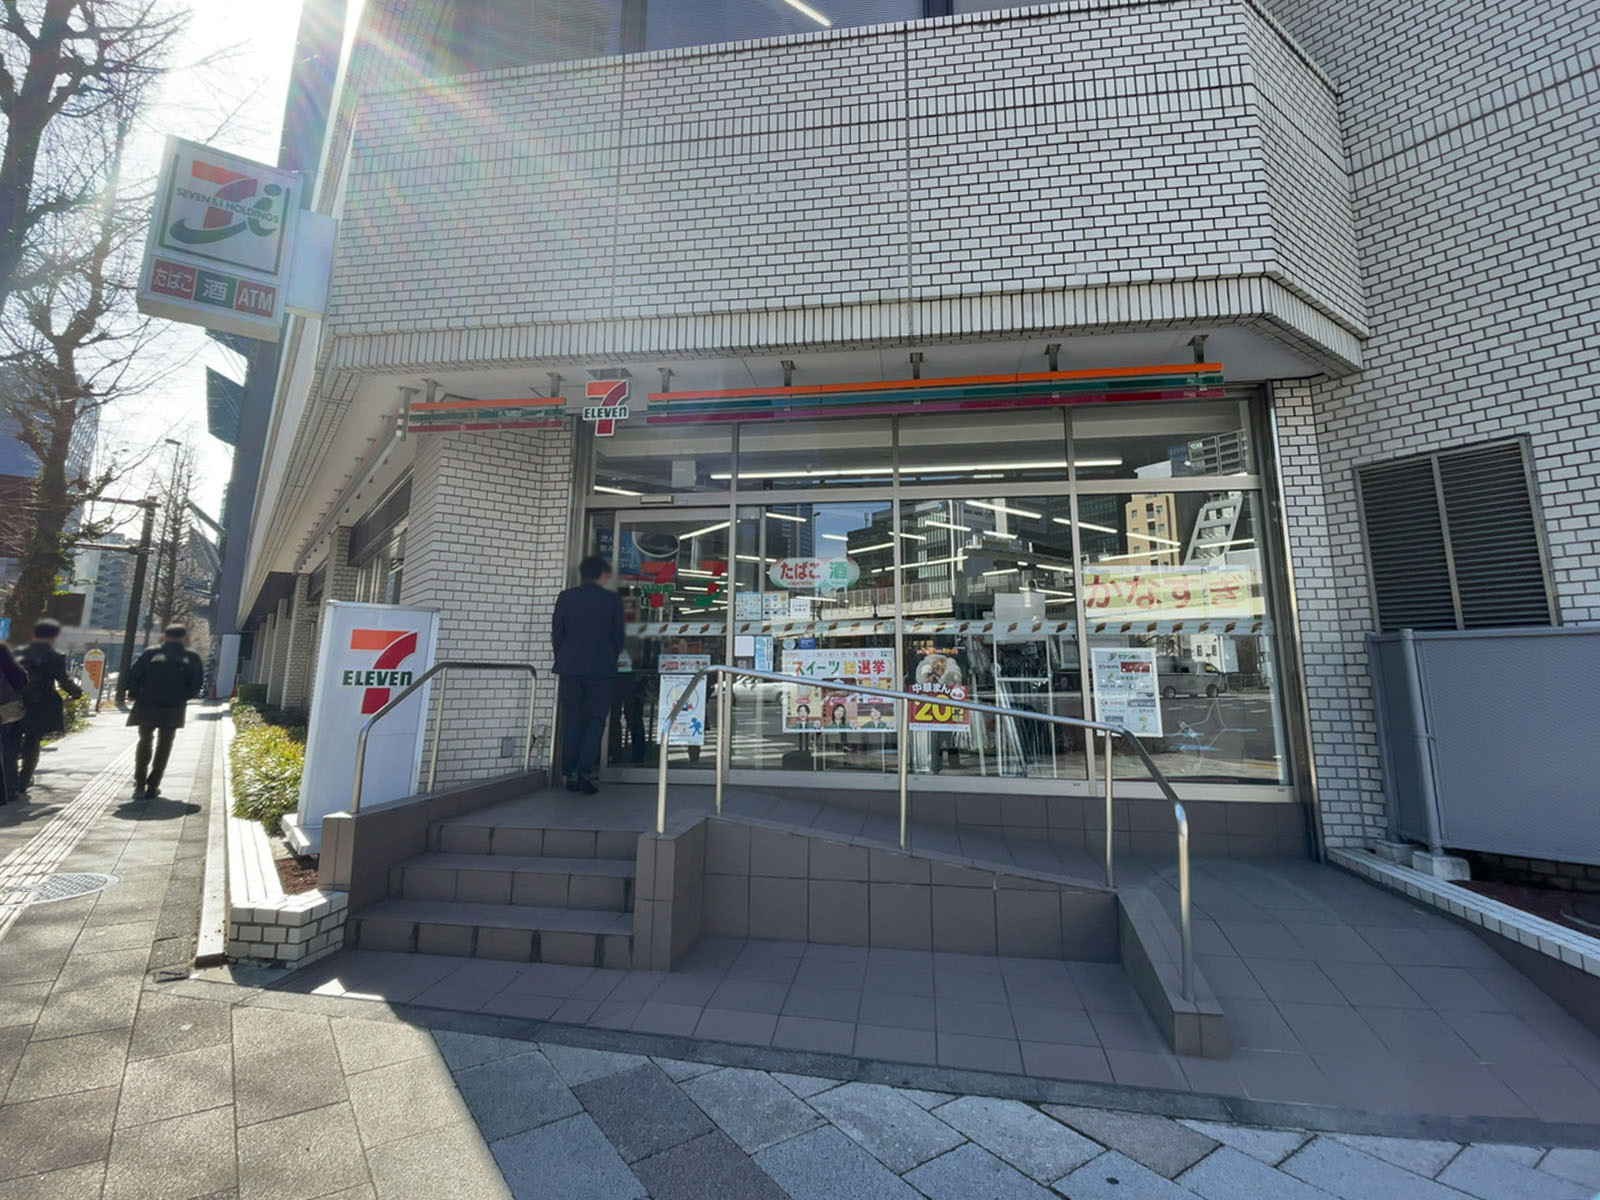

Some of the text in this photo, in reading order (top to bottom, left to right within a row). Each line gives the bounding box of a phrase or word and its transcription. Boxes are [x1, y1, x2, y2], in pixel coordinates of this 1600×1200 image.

[225, 202, 279, 224] HOLDINGS
[154, 268, 193, 293] たばこ
[202, 278, 229, 301] 酒
[238, 287, 273, 312] ATM
[780, 561, 847, 580] たばこ 酒
